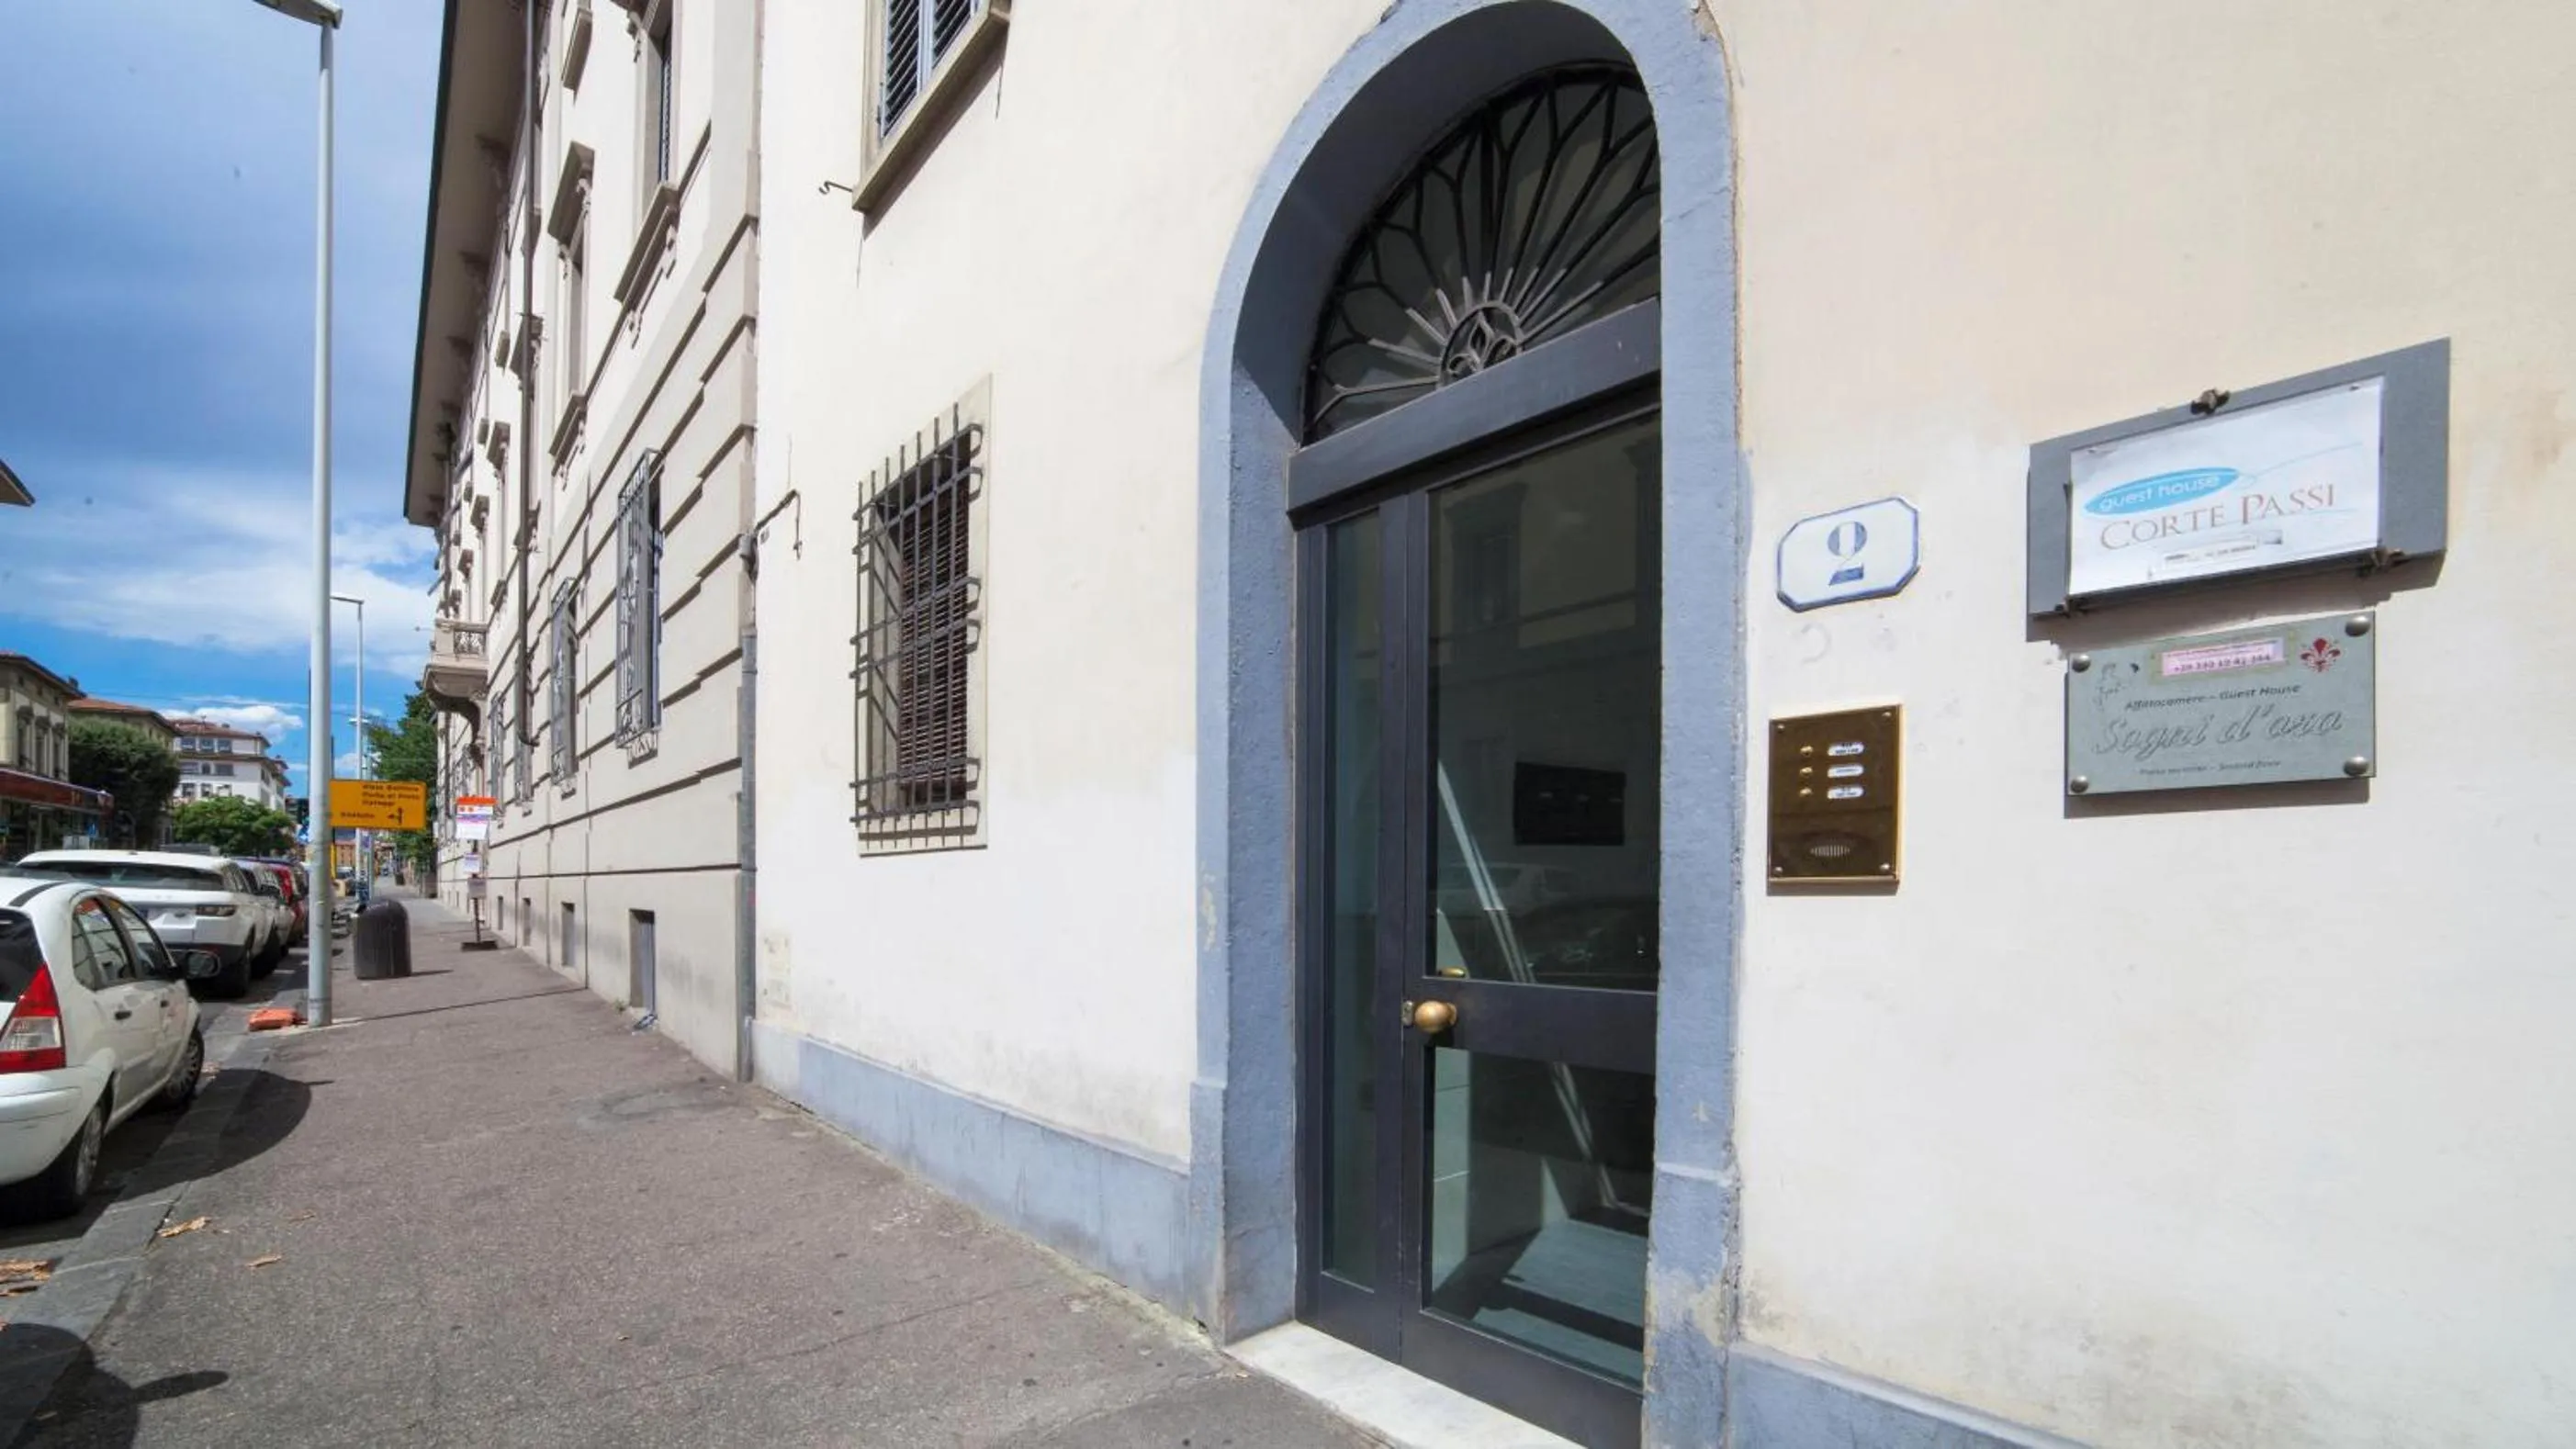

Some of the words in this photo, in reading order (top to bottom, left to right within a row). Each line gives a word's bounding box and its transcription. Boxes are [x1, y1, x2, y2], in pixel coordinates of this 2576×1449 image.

[2098, 488, 2152, 512] guest
[2158, 475, 2221, 498] house
[2100, 505, 2225, 550] CORTE
[2240, 483, 2334, 525] PASSI
[1827, 521, 1868, 587] 2
[2219, 688, 2256, 701] Guest
[2259, 685, 2300, 696] House
